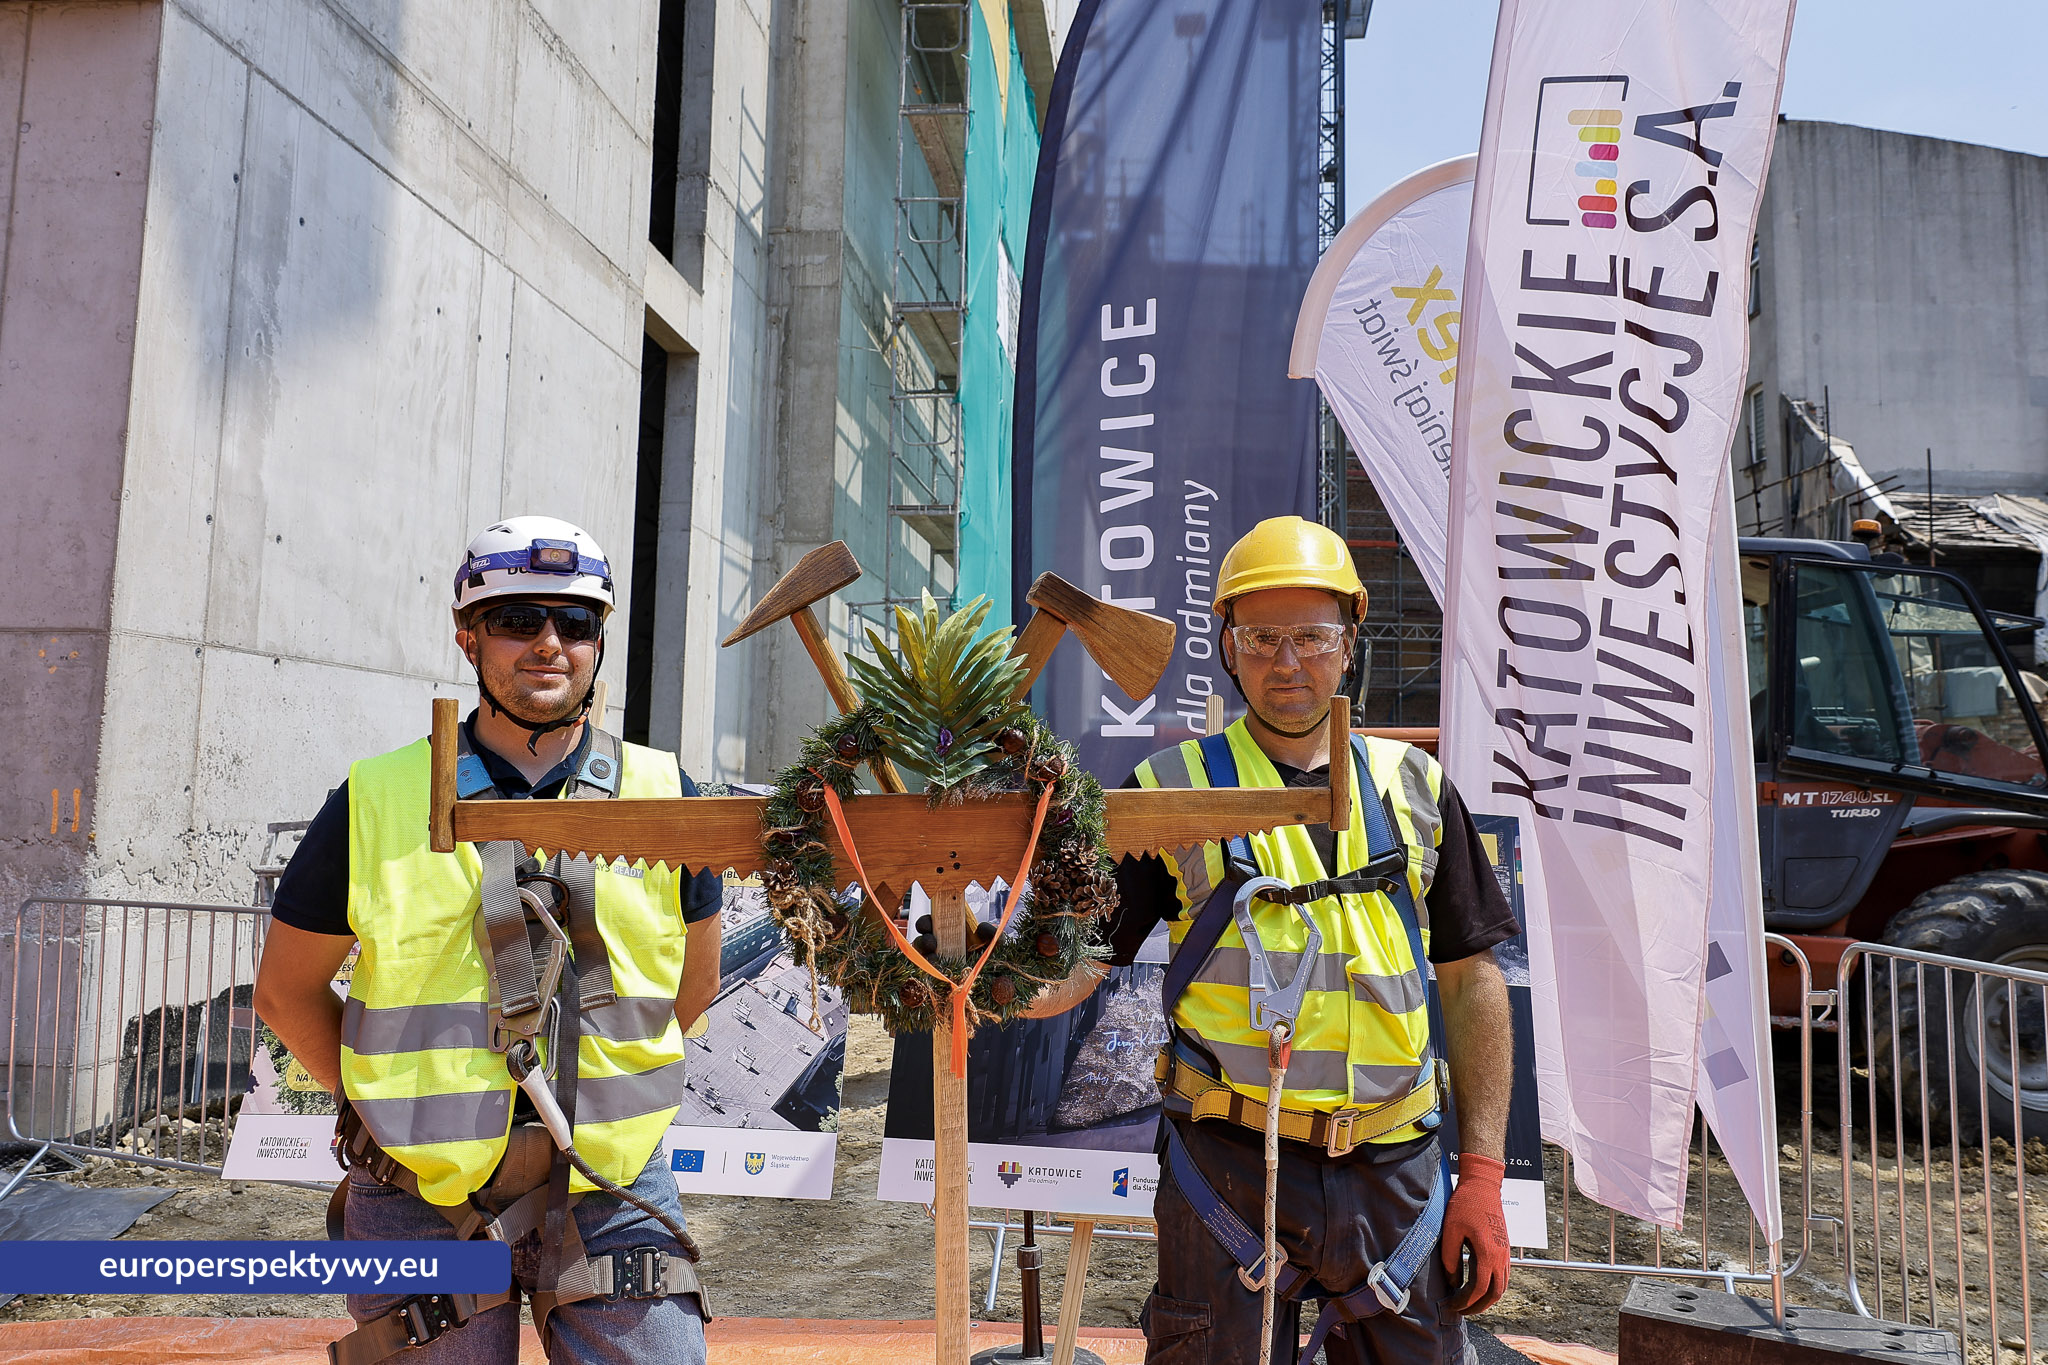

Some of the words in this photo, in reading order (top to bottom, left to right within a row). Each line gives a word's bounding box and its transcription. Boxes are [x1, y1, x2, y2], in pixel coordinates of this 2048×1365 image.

[1100, 298, 1157, 738] KTOWICE
[1492, 249, 1617, 821] KATOWICKIE
[1573, 257, 1719, 852] INWESTYCJE
[1176, 479, 1219, 660] odmiany
[1176, 674, 1213, 735] dla
[1782, 792, 1819, 805] MT
[1830, 808, 1881, 818] TURBO
[614, 866, 642, 877] READY
[296, 1074, 309, 1082] NA
[259, 1136, 301, 1147] KATOWICKIE
[1028, 1166, 1082, 1179] KATOWICE
